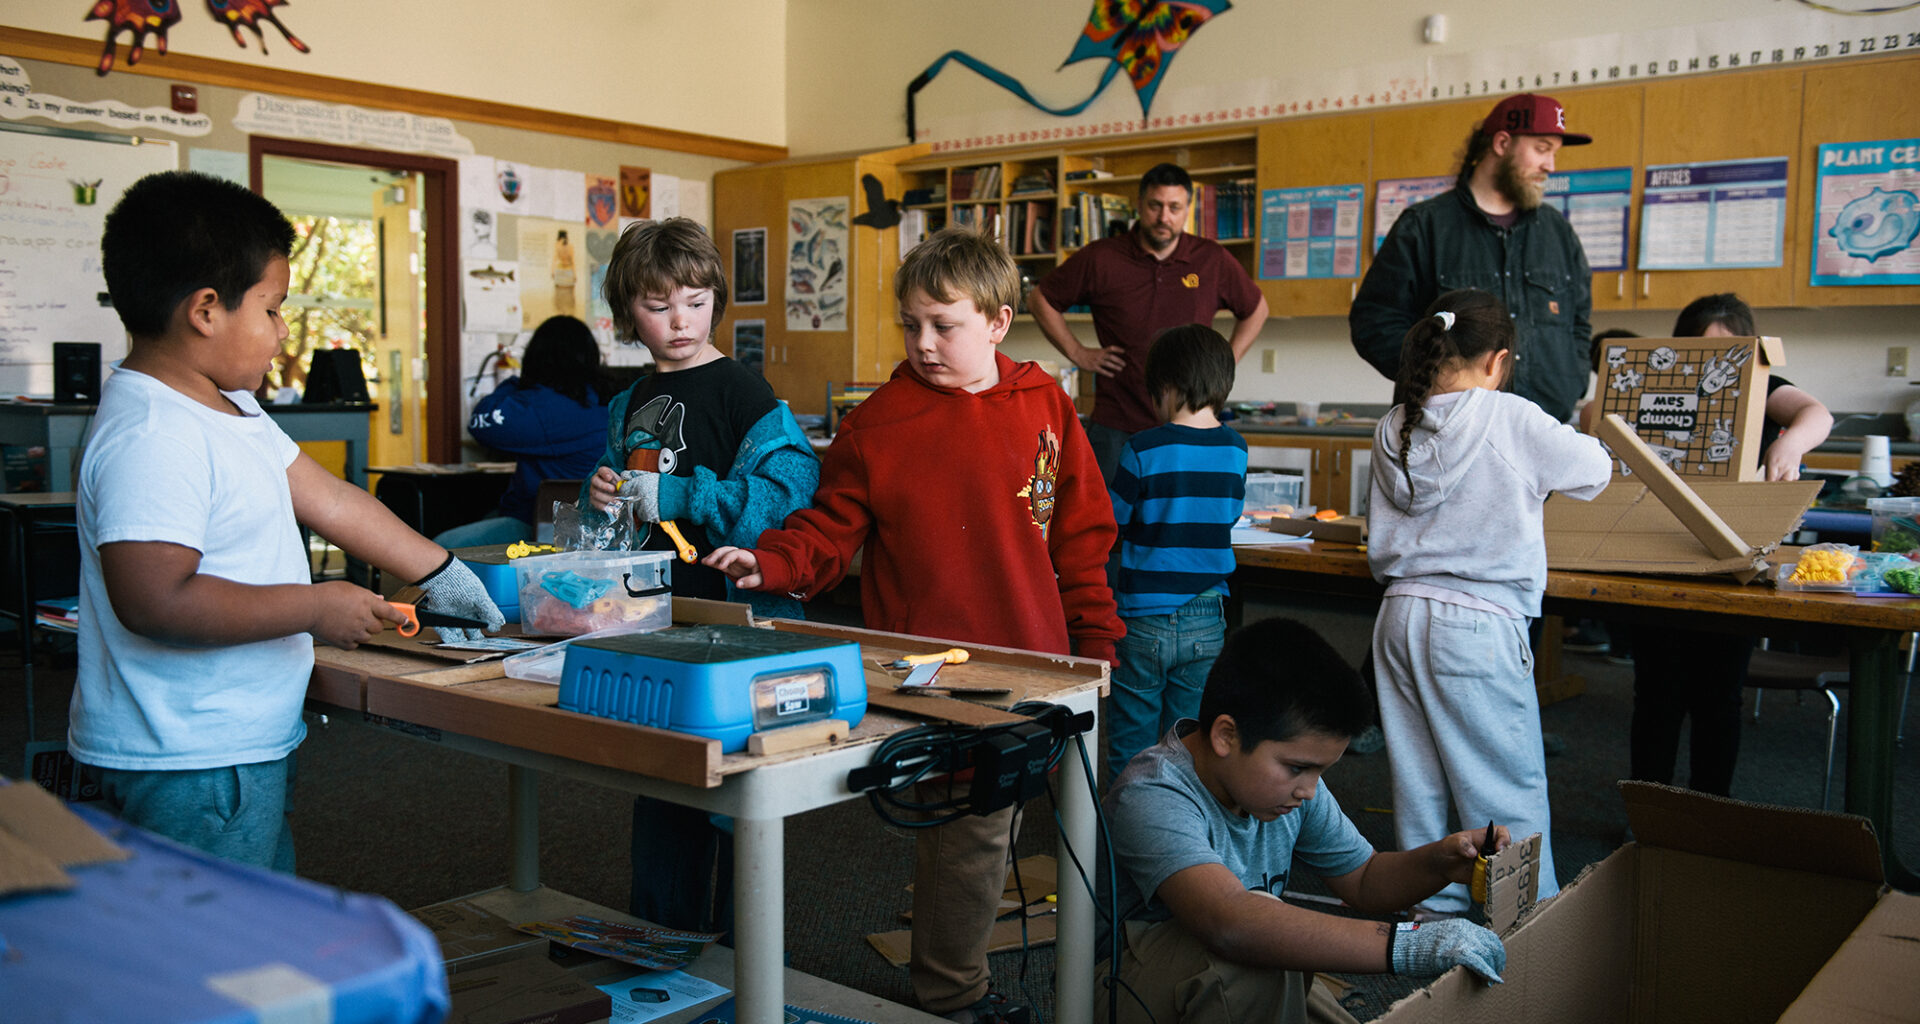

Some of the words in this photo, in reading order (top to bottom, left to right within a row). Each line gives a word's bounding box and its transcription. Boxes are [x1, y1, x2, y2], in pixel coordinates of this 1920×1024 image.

[1609, 66, 1620, 78] 10
[1629, 64, 1638, 76] 11
[1648, 62, 1658, 75] 12
[1667, 60, 1678, 72] 13
[1689, 57, 1699, 69] 14
[1709, 55, 1719, 68] 15
[1729, 53, 1740, 66] 16
[1751, 51, 1761, 64] 17
[1772, 49, 1783, 62] 18
[1794, 47, 1805, 60] 19
[1815, 45, 1828, 57] 20
[1839, 41, 1850, 54] 21
[1860, 38, 1875, 52] 22
[1884, 35, 1899, 49] 23
[1907, 32, 1920, 47] 24
[27, 99, 40, 109] Is
[45, 103, 61, 114] my
[66, 106, 104, 117] answer
[109, 109, 140, 121] based
[145, 114, 157, 122] on
[161, 114, 178, 125] the
[181, 117, 209, 128] text?
[257, 96, 342, 121] Discussion
[348, 107, 406, 131] Ground
[412, 115, 451, 136] Rules
[1506, 109, 1531, 130] 91
[1823, 147, 1884, 167] PLANT
[1890, 145, 1920, 164] CE
[1543, 176, 1570, 192] ORDS
[1651, 169, 1691, 187] AFFIXES
[1653, 396, 1685, 408] Saw
[1640, 413, 1694, 428] Chomp
